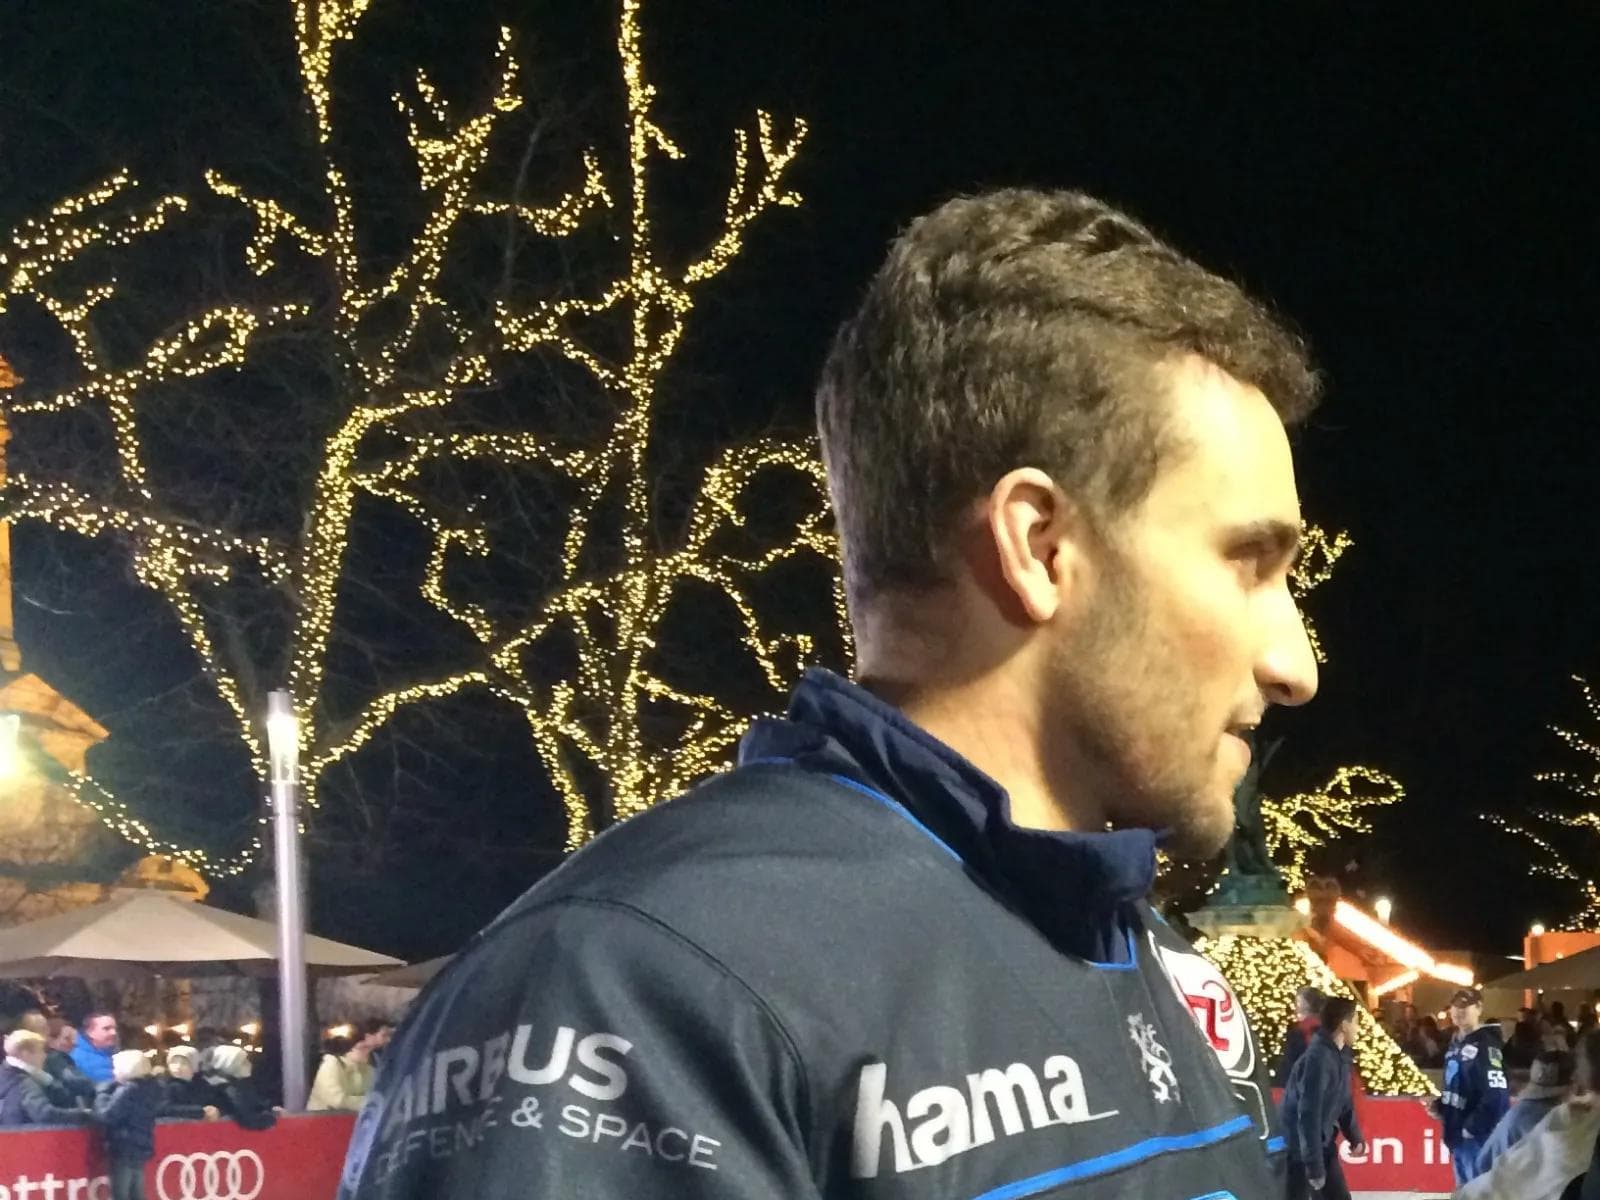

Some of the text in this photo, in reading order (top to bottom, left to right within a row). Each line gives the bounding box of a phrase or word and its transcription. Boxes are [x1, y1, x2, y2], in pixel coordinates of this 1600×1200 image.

[1487, 1069, 1508, 1089] 55
[511, 1097, 544, 1130] &
[558, 1104, 722, 1170] SPACE
[853, 1055, 1120, 1178] hama
